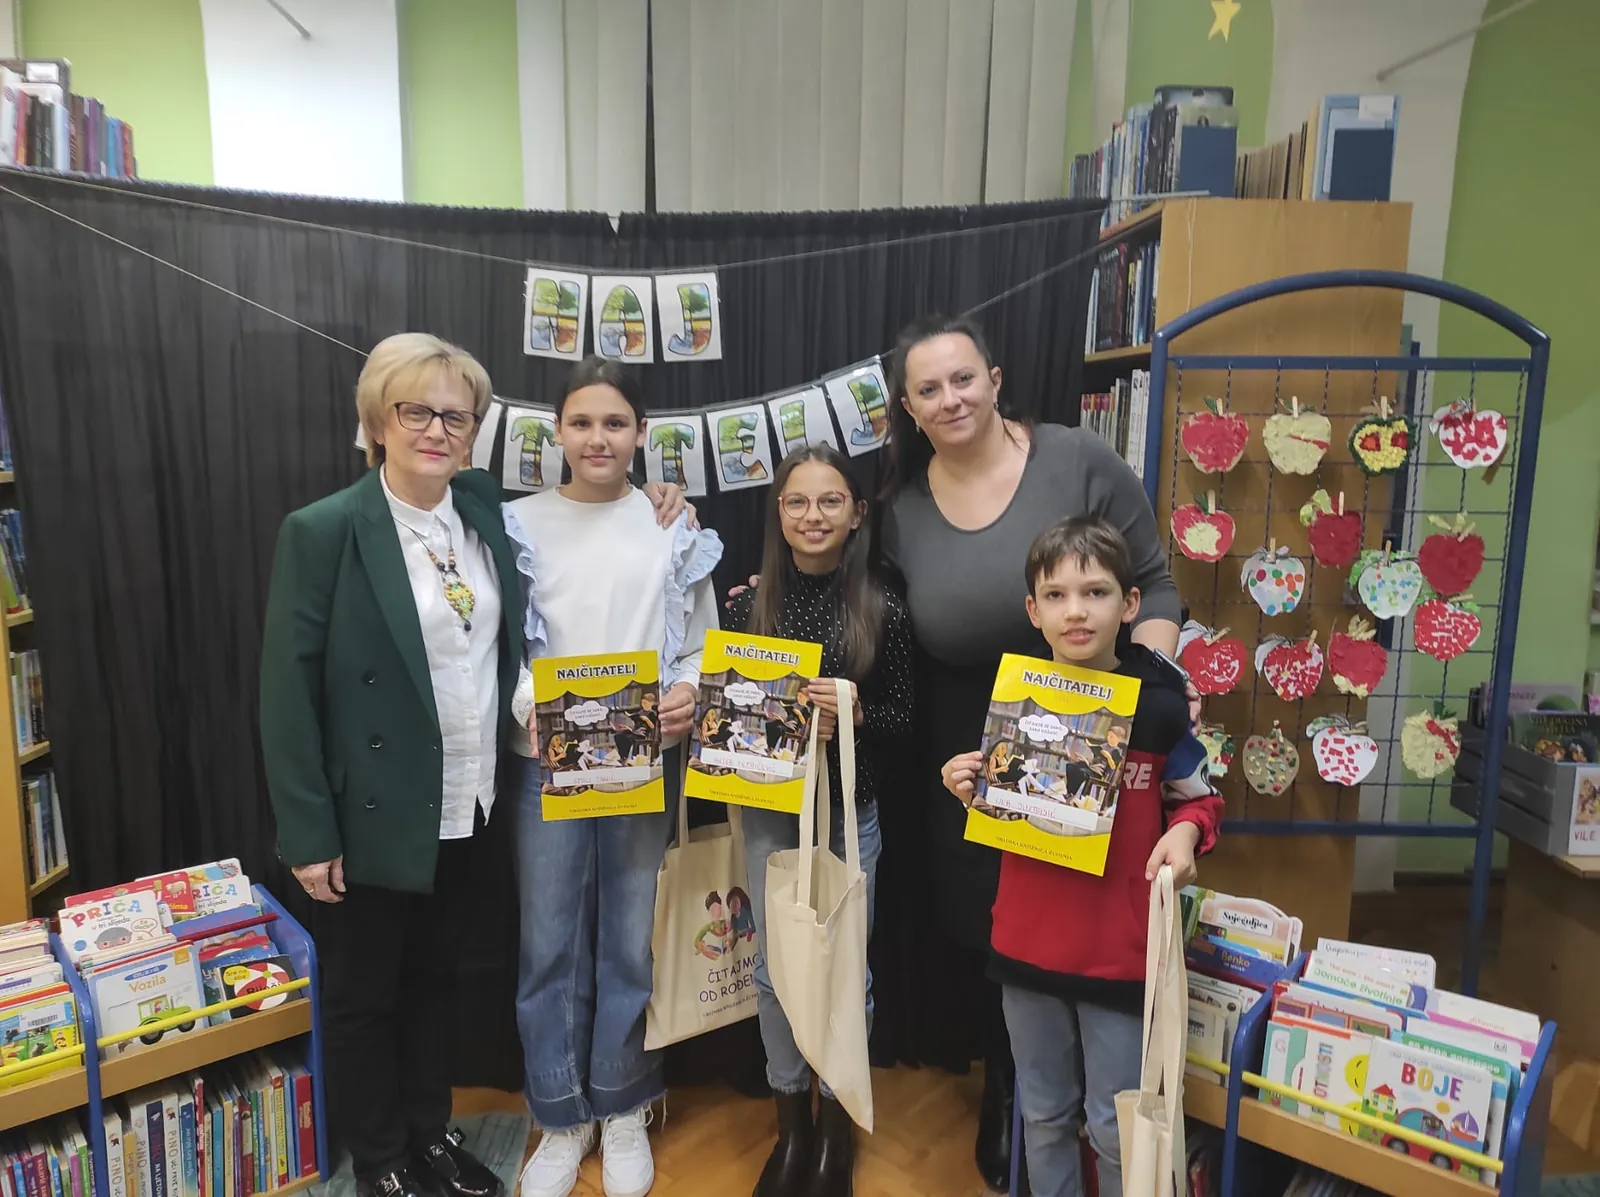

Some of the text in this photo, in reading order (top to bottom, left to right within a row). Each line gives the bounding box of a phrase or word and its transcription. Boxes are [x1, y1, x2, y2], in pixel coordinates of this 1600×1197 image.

[530, 276, 713, 358] NAJ
[724, 643, 800, 666] NAJČITATELJ
[556, 662, 637, 681] NAJČITATELJ
[1022, 671, 1114, 700] NAJČITATELJ
[71, 899, 142, 928] PRIČA
[128, 975, 167, 992] Vozila
[699, 990, 718, 1003] OD
[1400, 1062, 1464, 1102] BOJE
